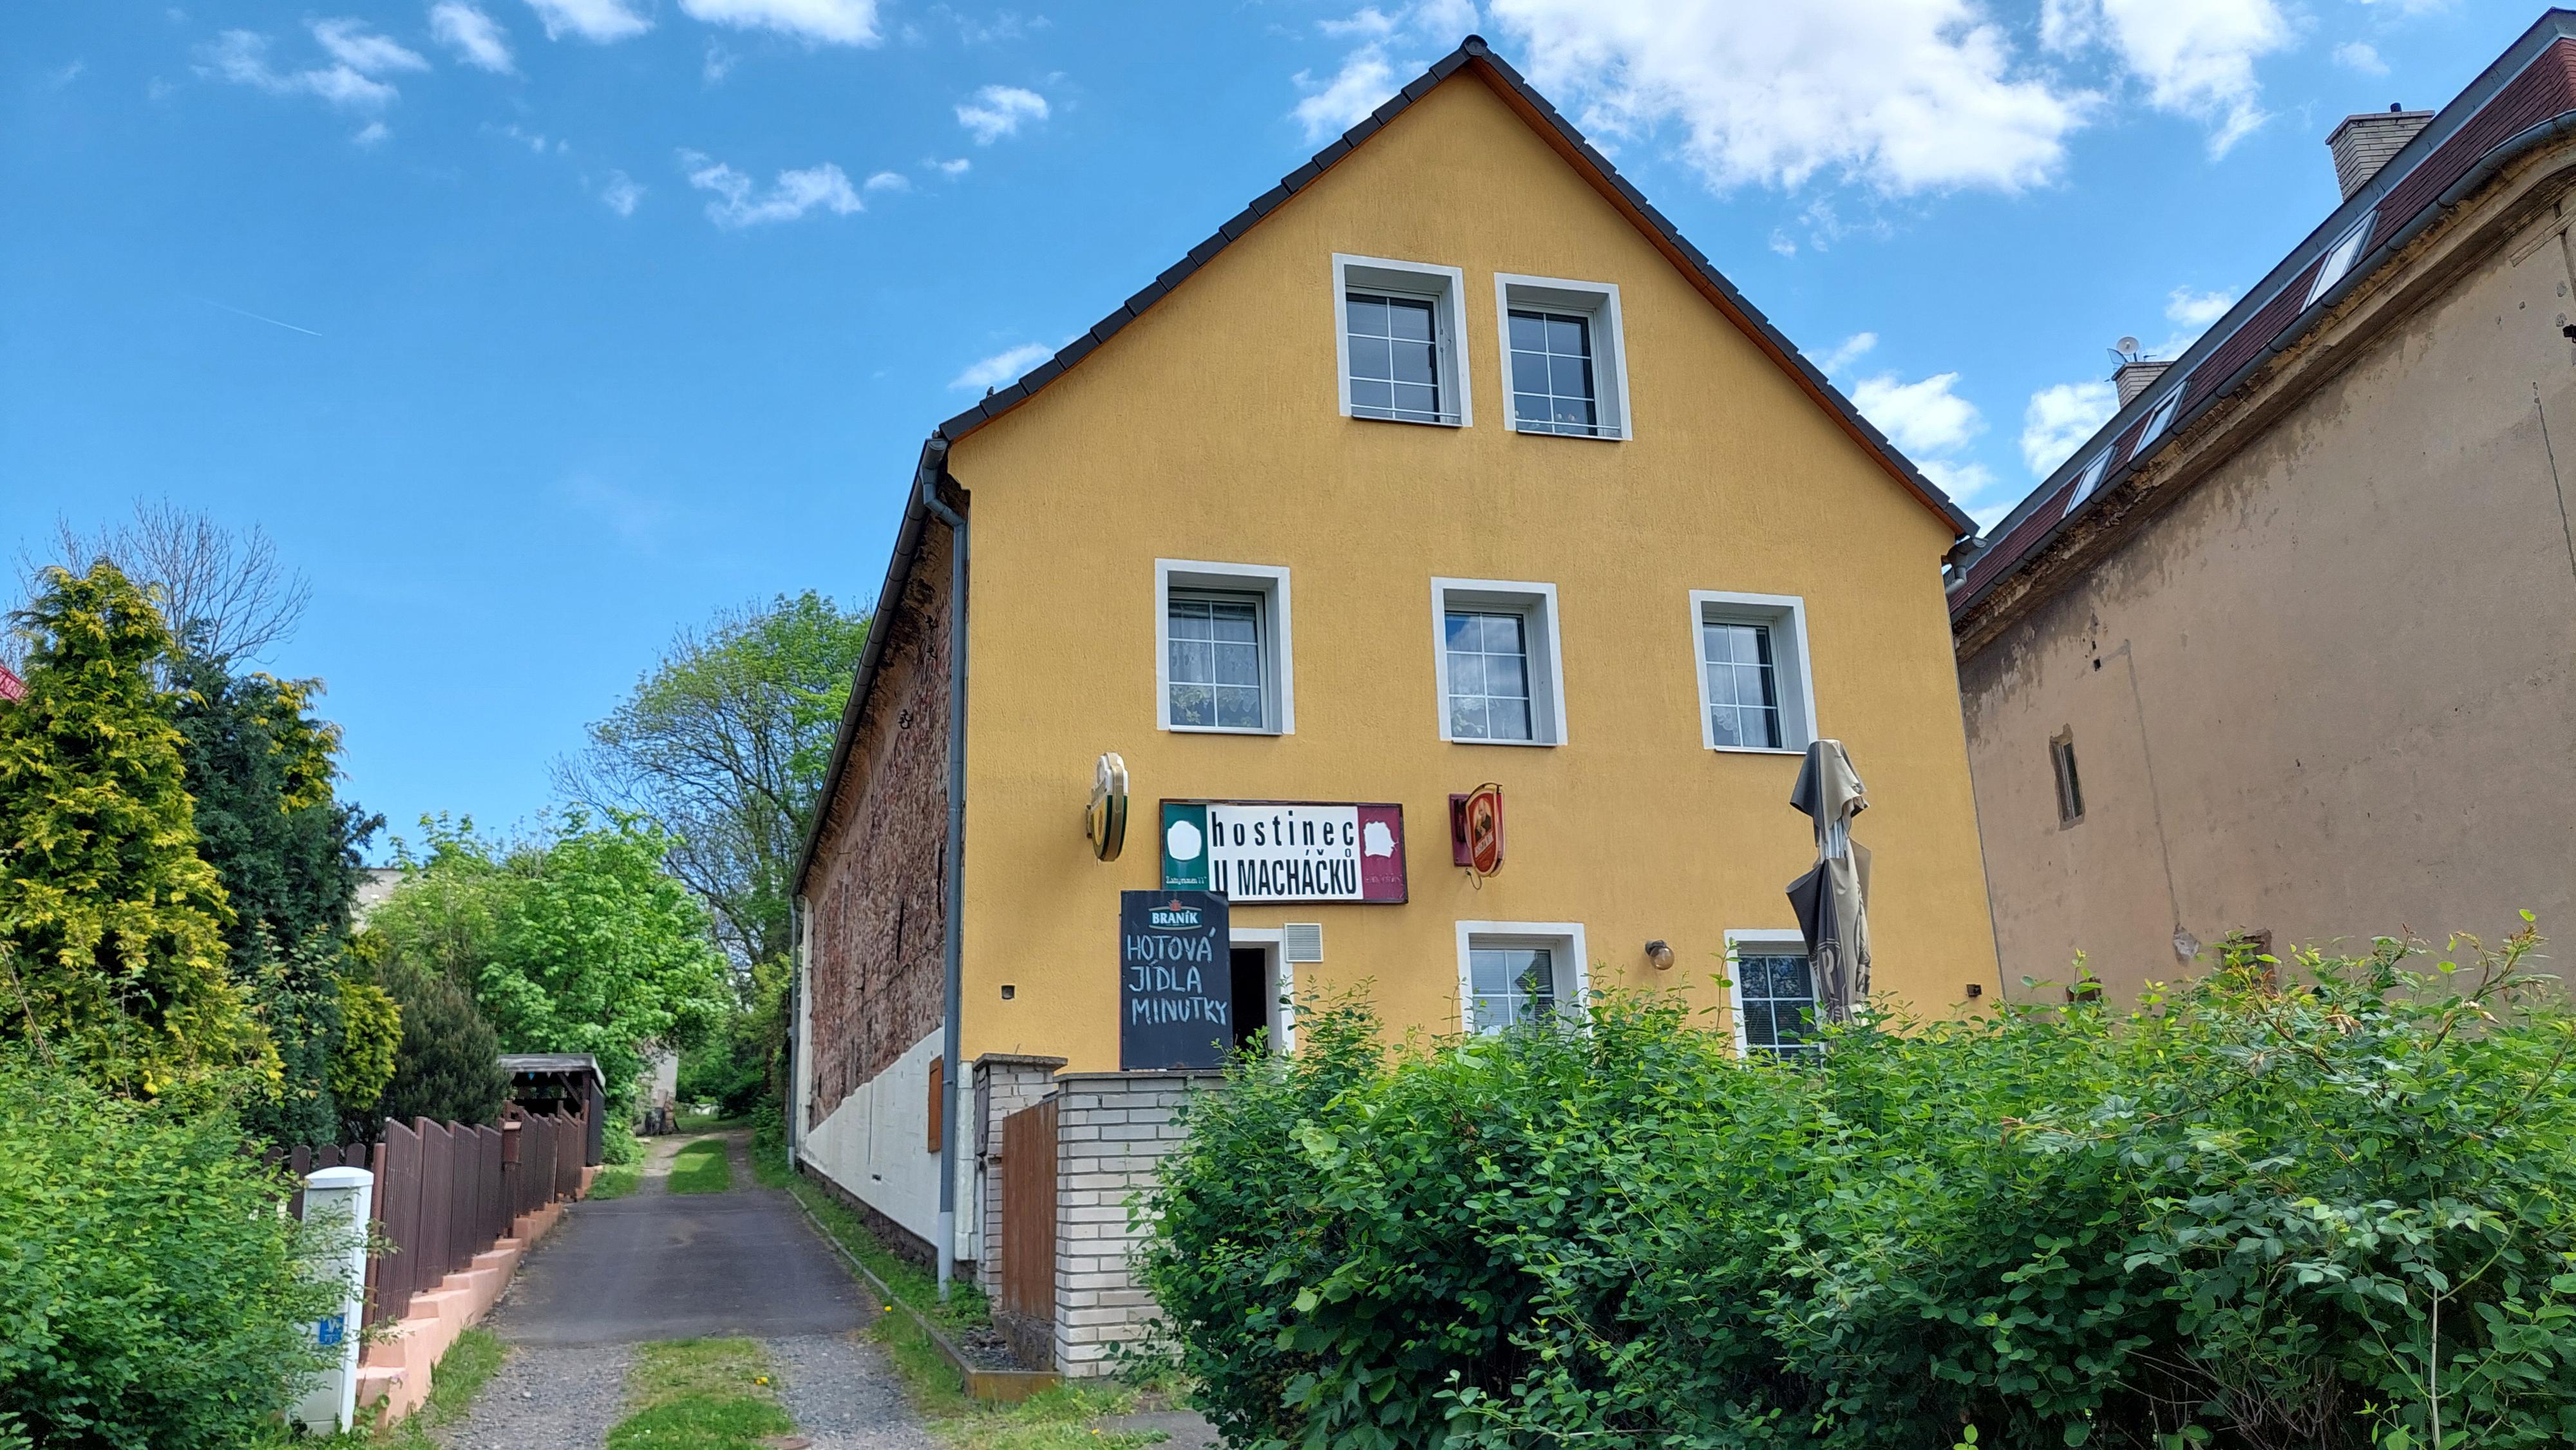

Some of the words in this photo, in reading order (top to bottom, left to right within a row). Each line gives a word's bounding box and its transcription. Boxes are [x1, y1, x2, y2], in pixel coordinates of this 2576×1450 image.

[1211, 810, 1354, 847] hostinec
[1214, 860, 1227, 891] U
[1237, 849, 1356, 896] MACHÁČKŮ
[1152, 910, 1198, 924] BRANÍK
[1127, 927, 1217, 963] HOTOVÁ
[1128, 959, 1203, 994] JÍDLA
[1132, 997, 1227, 1026] MINUTKY
